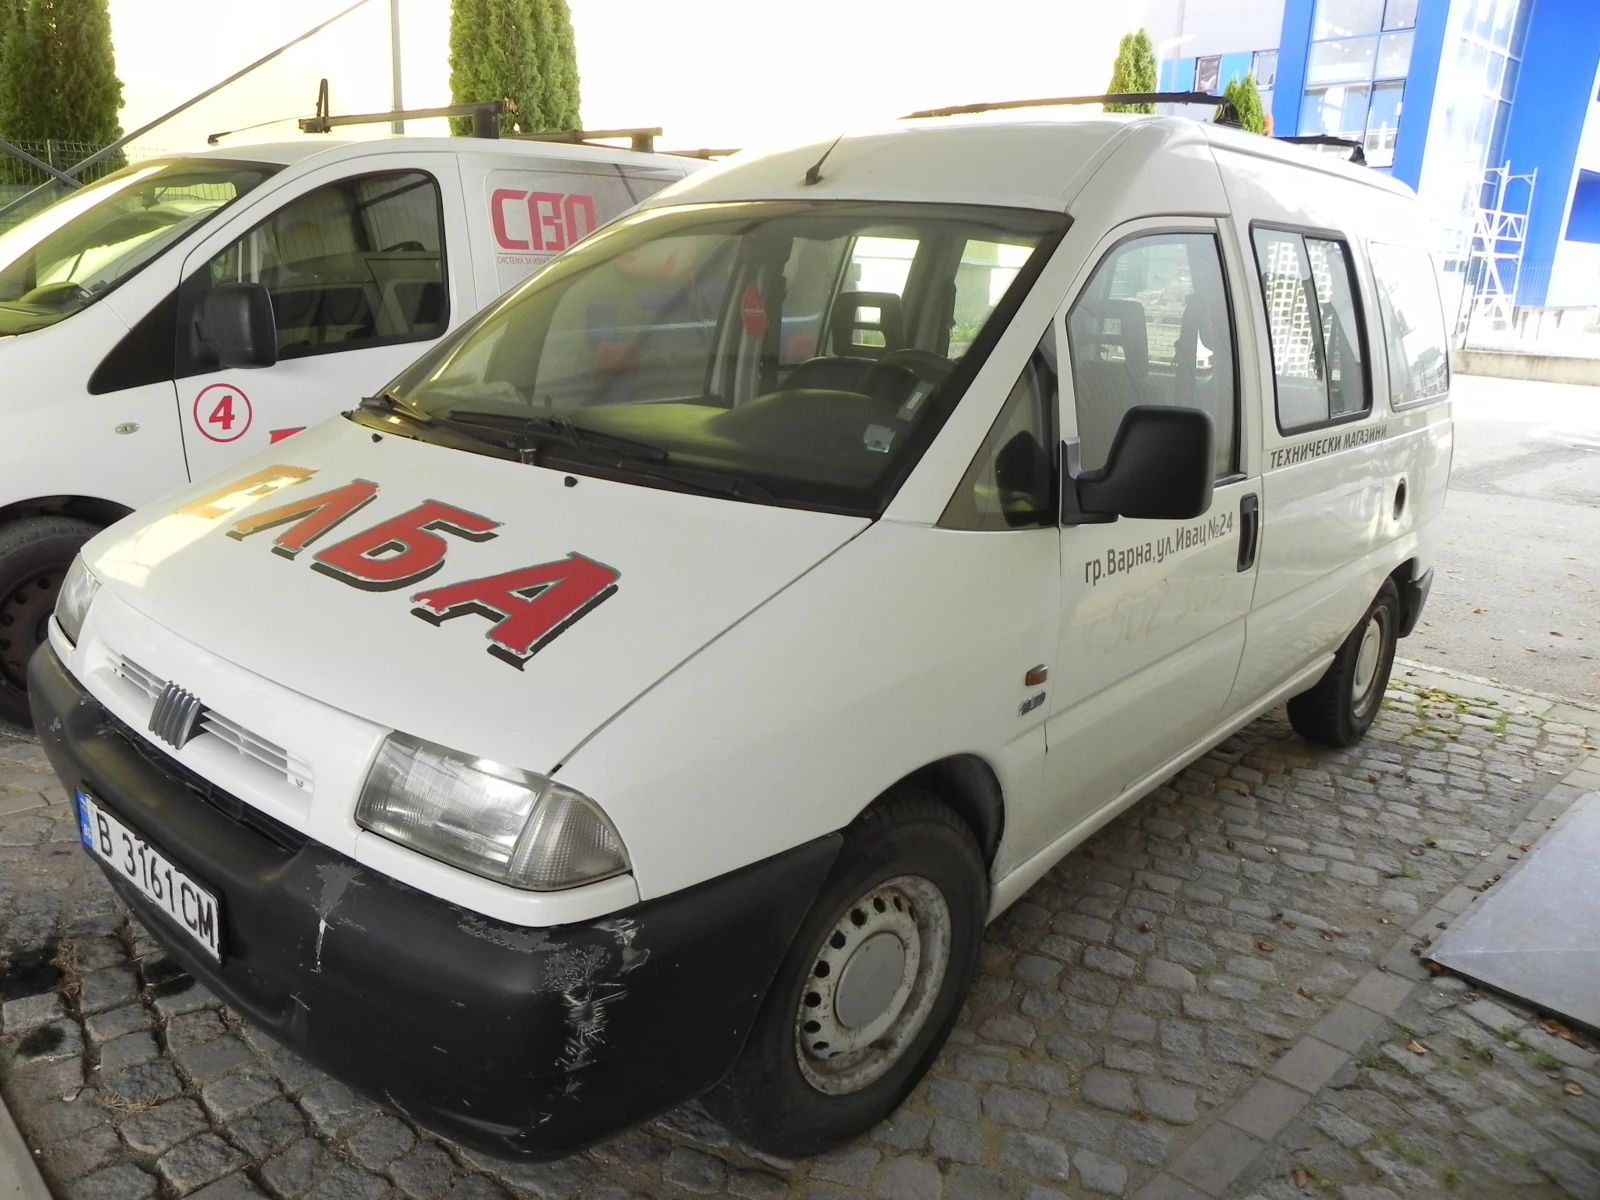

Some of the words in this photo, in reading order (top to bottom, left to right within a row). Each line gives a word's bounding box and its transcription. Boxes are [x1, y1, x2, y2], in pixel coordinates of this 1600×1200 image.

[497, 256, 525, 265] СИСТЕМА
[525, 257, 533, 265] ЗА
[208, 395, 235, 430] 4
[1270, 435, 1342, 469] ТЕХНИЧЕСКИ
[1342, 424, 1388, 449] МАГАЗИНИ
[174, 464, 621, 671] ЕЛБА
[96, 812, 113, 858] B
[122, 832, 176, 914] 3161
[181, 881, 215, 949] CM
